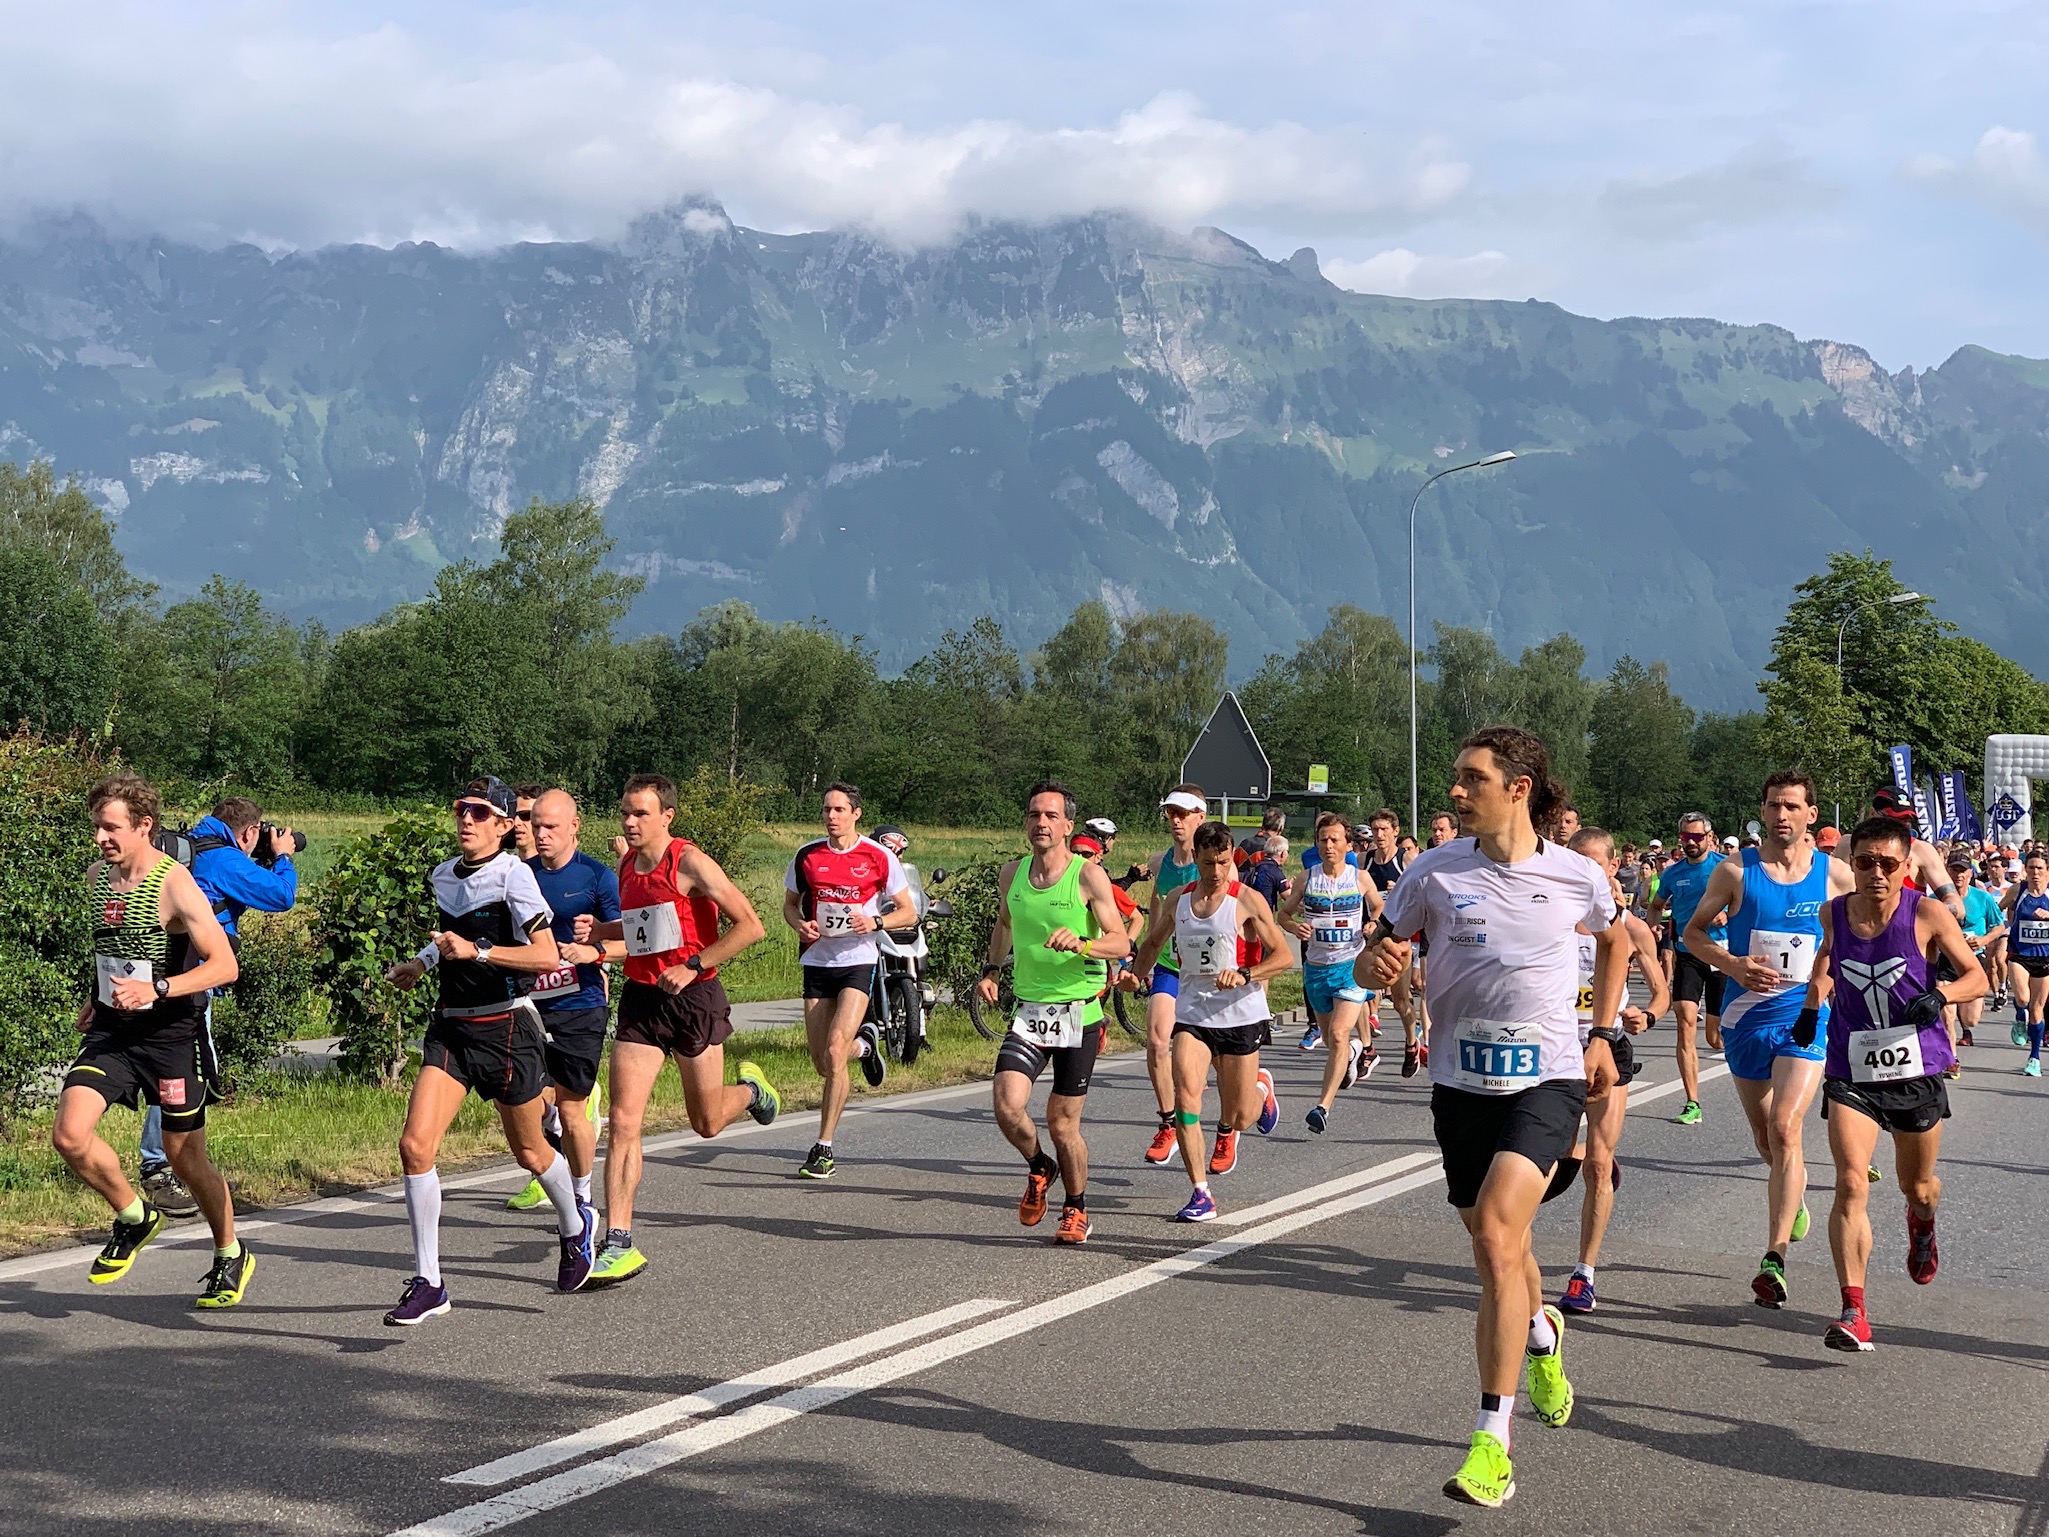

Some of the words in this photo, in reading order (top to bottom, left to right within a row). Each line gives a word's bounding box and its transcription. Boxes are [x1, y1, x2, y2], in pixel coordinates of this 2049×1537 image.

[1996, 809, 2020, 821] LGT
[636, 926, 647, 943] 4
[1318, 930, 1351, 941] 1118
[2023, 929, 2049, 938] 1018
[1201, 951, 1210, 965] 5
[1780, 952, 1789, 968] 1
[1026, 1019, 1061, 1036] 304
[1465, 1045, 1534, 1073] 1113
[1864, 1046, 1911, 1068] 402
